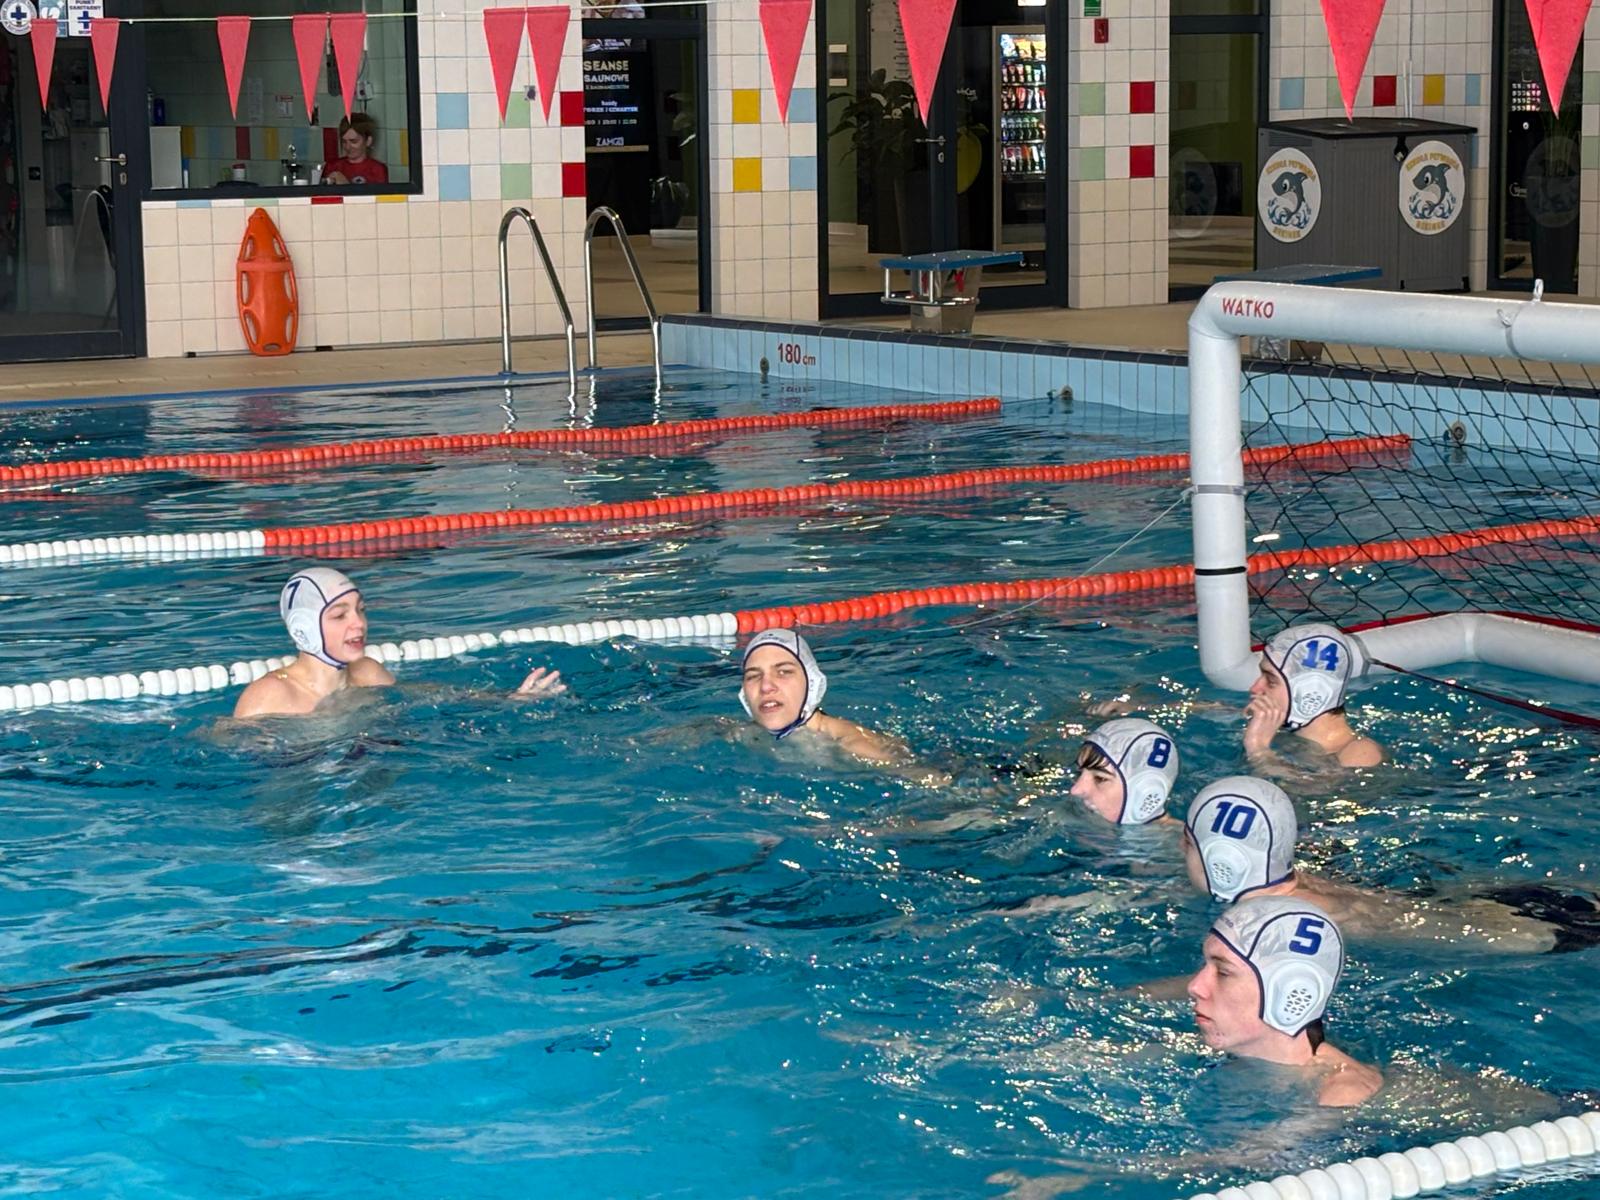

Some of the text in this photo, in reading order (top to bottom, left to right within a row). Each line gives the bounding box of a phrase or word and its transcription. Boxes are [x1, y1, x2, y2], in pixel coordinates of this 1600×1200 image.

[583, 60, 629, 71] SEANSE
[584, 73, 630, 83] SAUNOWE
[1222, 298, 1274, 319] WATKO
[777, 342, 816, 366] 180 cm
[287, 580, 301, 610] 7
[1301, 640, 1339, 671] 14
[1147, 737, 1171, 769] 8
[1210, 801, 1257, 840] 10
[1289, 917, 1325, 956] 5
